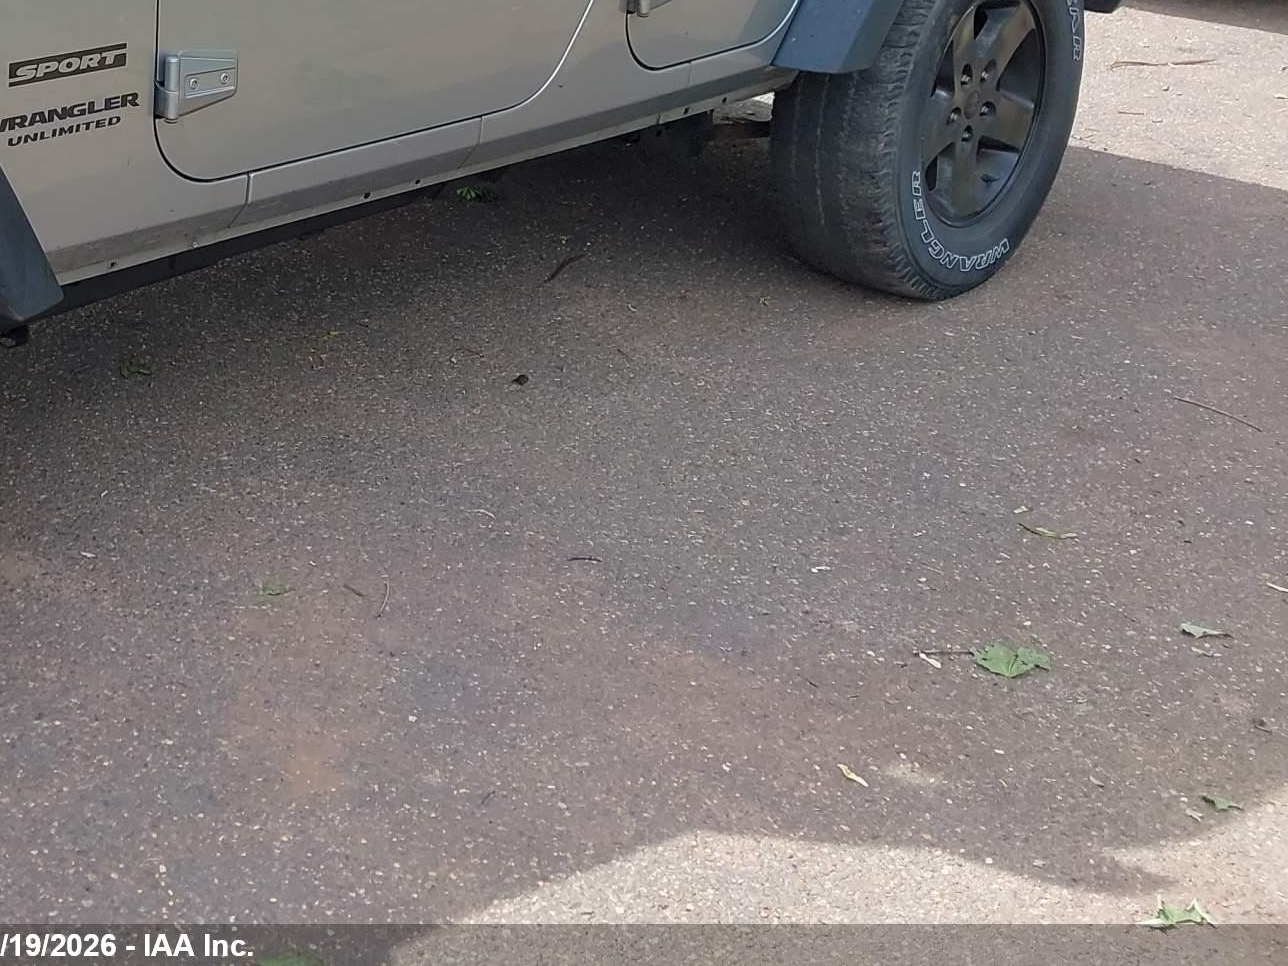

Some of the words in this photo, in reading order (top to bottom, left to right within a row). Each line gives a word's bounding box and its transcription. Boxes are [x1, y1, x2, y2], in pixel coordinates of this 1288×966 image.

[9, 48, 127, 83] SPORT
[7, 115, 122, 148] UNLIMITED
[911, 170, 1011, 272] WRANGLER
